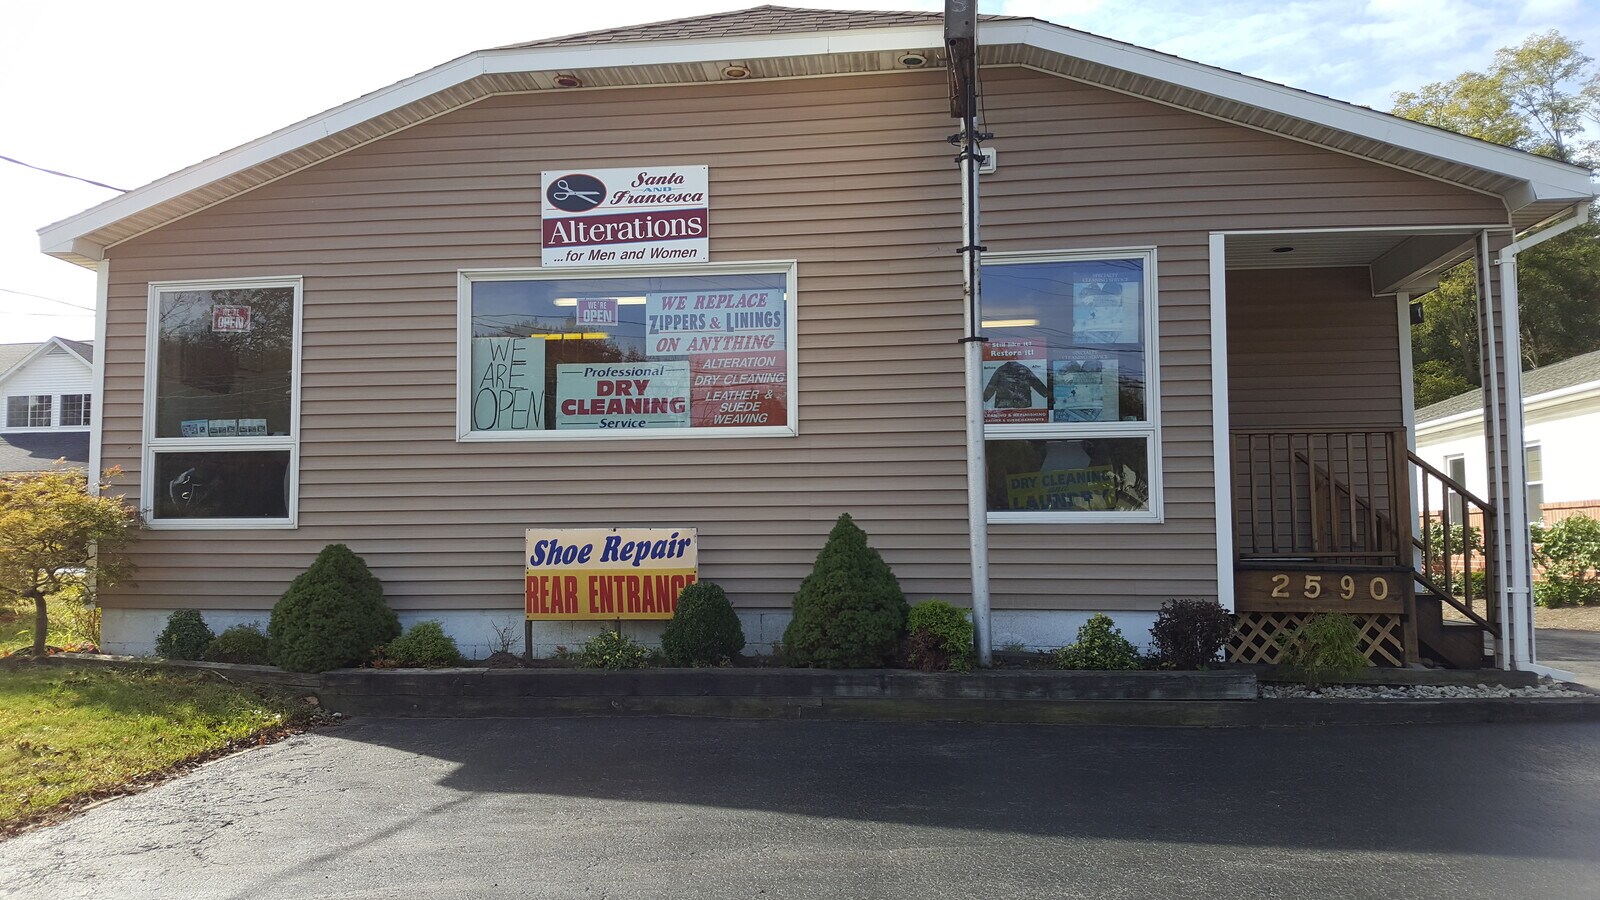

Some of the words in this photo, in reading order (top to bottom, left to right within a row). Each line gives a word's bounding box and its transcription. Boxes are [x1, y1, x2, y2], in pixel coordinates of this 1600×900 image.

[631, 171, 685, 188] Santo
[610, 190, 704, 206] Francesca
[548, 215, 703, 245] Alterations
[588, 249, 616, 262] Men
[620, 248, 645, 260] and
[650, 247, 697, 260] Women
[588, 301, 607, 309] WE'RE
[662, 295, 687, 311] WE
[693, 293, 768, 310] REPLACE
[218, 316, 244, 329] OPEN
[583, 309, 612, 322] OPEN
[649, 313, 706, 334] ZIPPERS
[709, 316, 721, 330] &
[726, 311, 781, 332] LININGS
[489, 338, 526, 362] WE
[656, 337, 681, 353] ON
[686, 334, 775, 351] ANYTHING
[702, 356, 776, 369] ALTERATION
[480, 362, 528, 390] ARE
[583, 366, 664, 378] Professional
[694, 375, 719, 386] DRY
[724, 373, 785, 385] CLEANING
[597, 379, 650, 396] DRY
[705, 390, 759, 401] LEATHER
[764, 389, 773, 399] &
[474, 387, 545, 430] OPEN
[561, 397, 686, 416] CLEANING
[719, 401, 761, 413] SUEDE
[599, 418, 646, 429] Service
[713, 413, 768, 425] WEAVING
[1012, 476, 1037, 490] DRY
[1042, 469, 1110, 487] CLEANING
[530, 538, 593, 567] Shoe
[600, 531, 691, 567] Repair
[526, 575, 579, 614] REAR
[588, 574, 696, 614] ENTRANC
[1271, 574, 1389, 601] 2590
